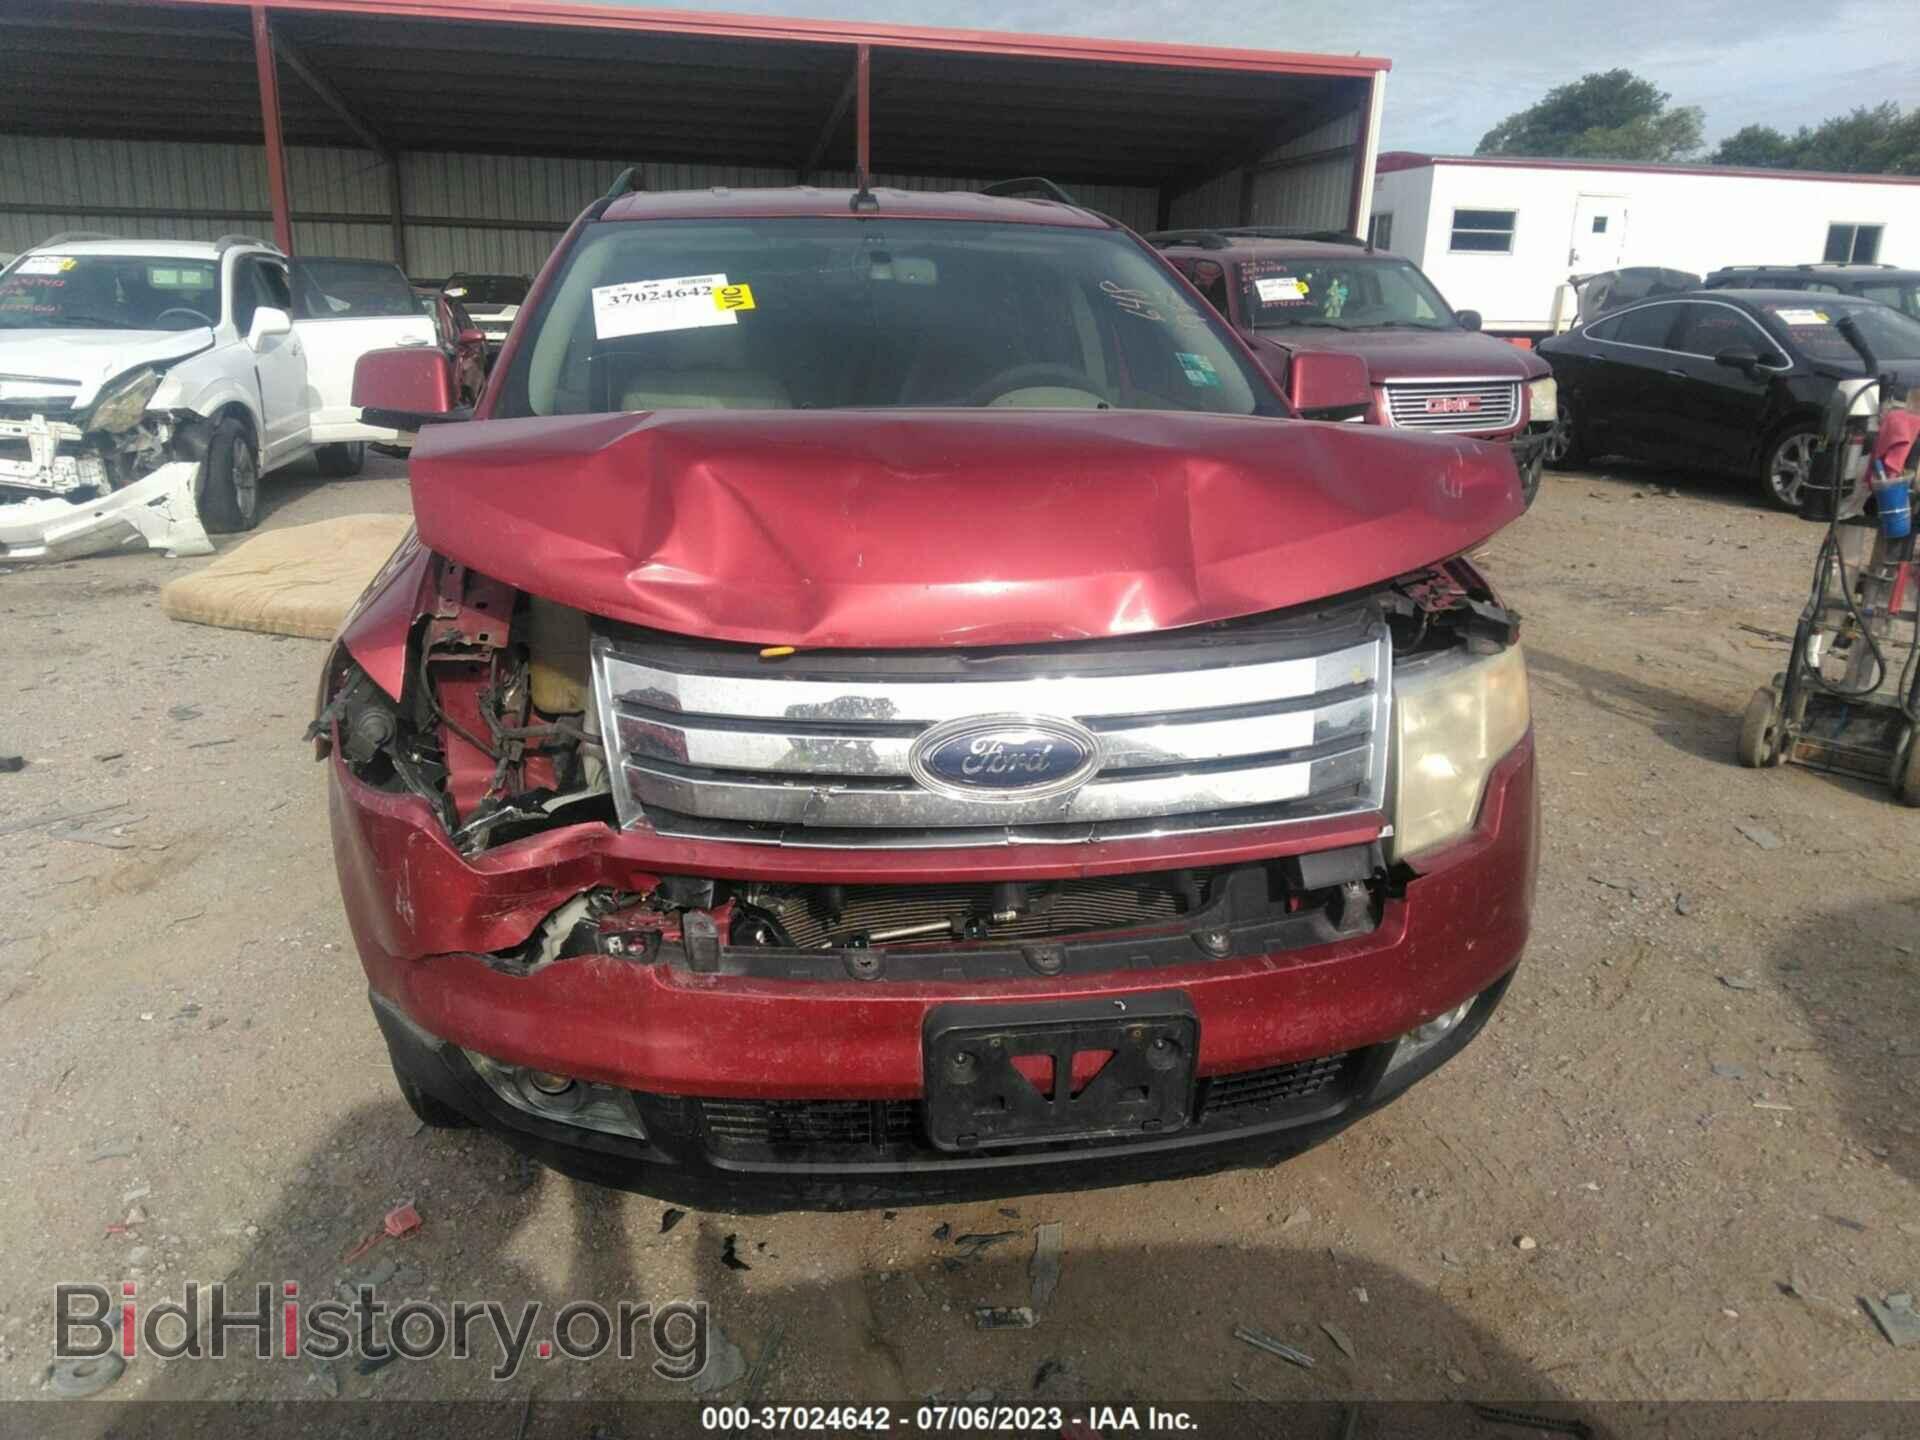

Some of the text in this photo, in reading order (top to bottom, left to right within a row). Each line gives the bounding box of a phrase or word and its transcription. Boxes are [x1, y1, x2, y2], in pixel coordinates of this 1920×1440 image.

[608, 286, 713, 306] 37024642
[721, 286, 745, 309] VIC
[962, 738, 1053, 774] Ford
